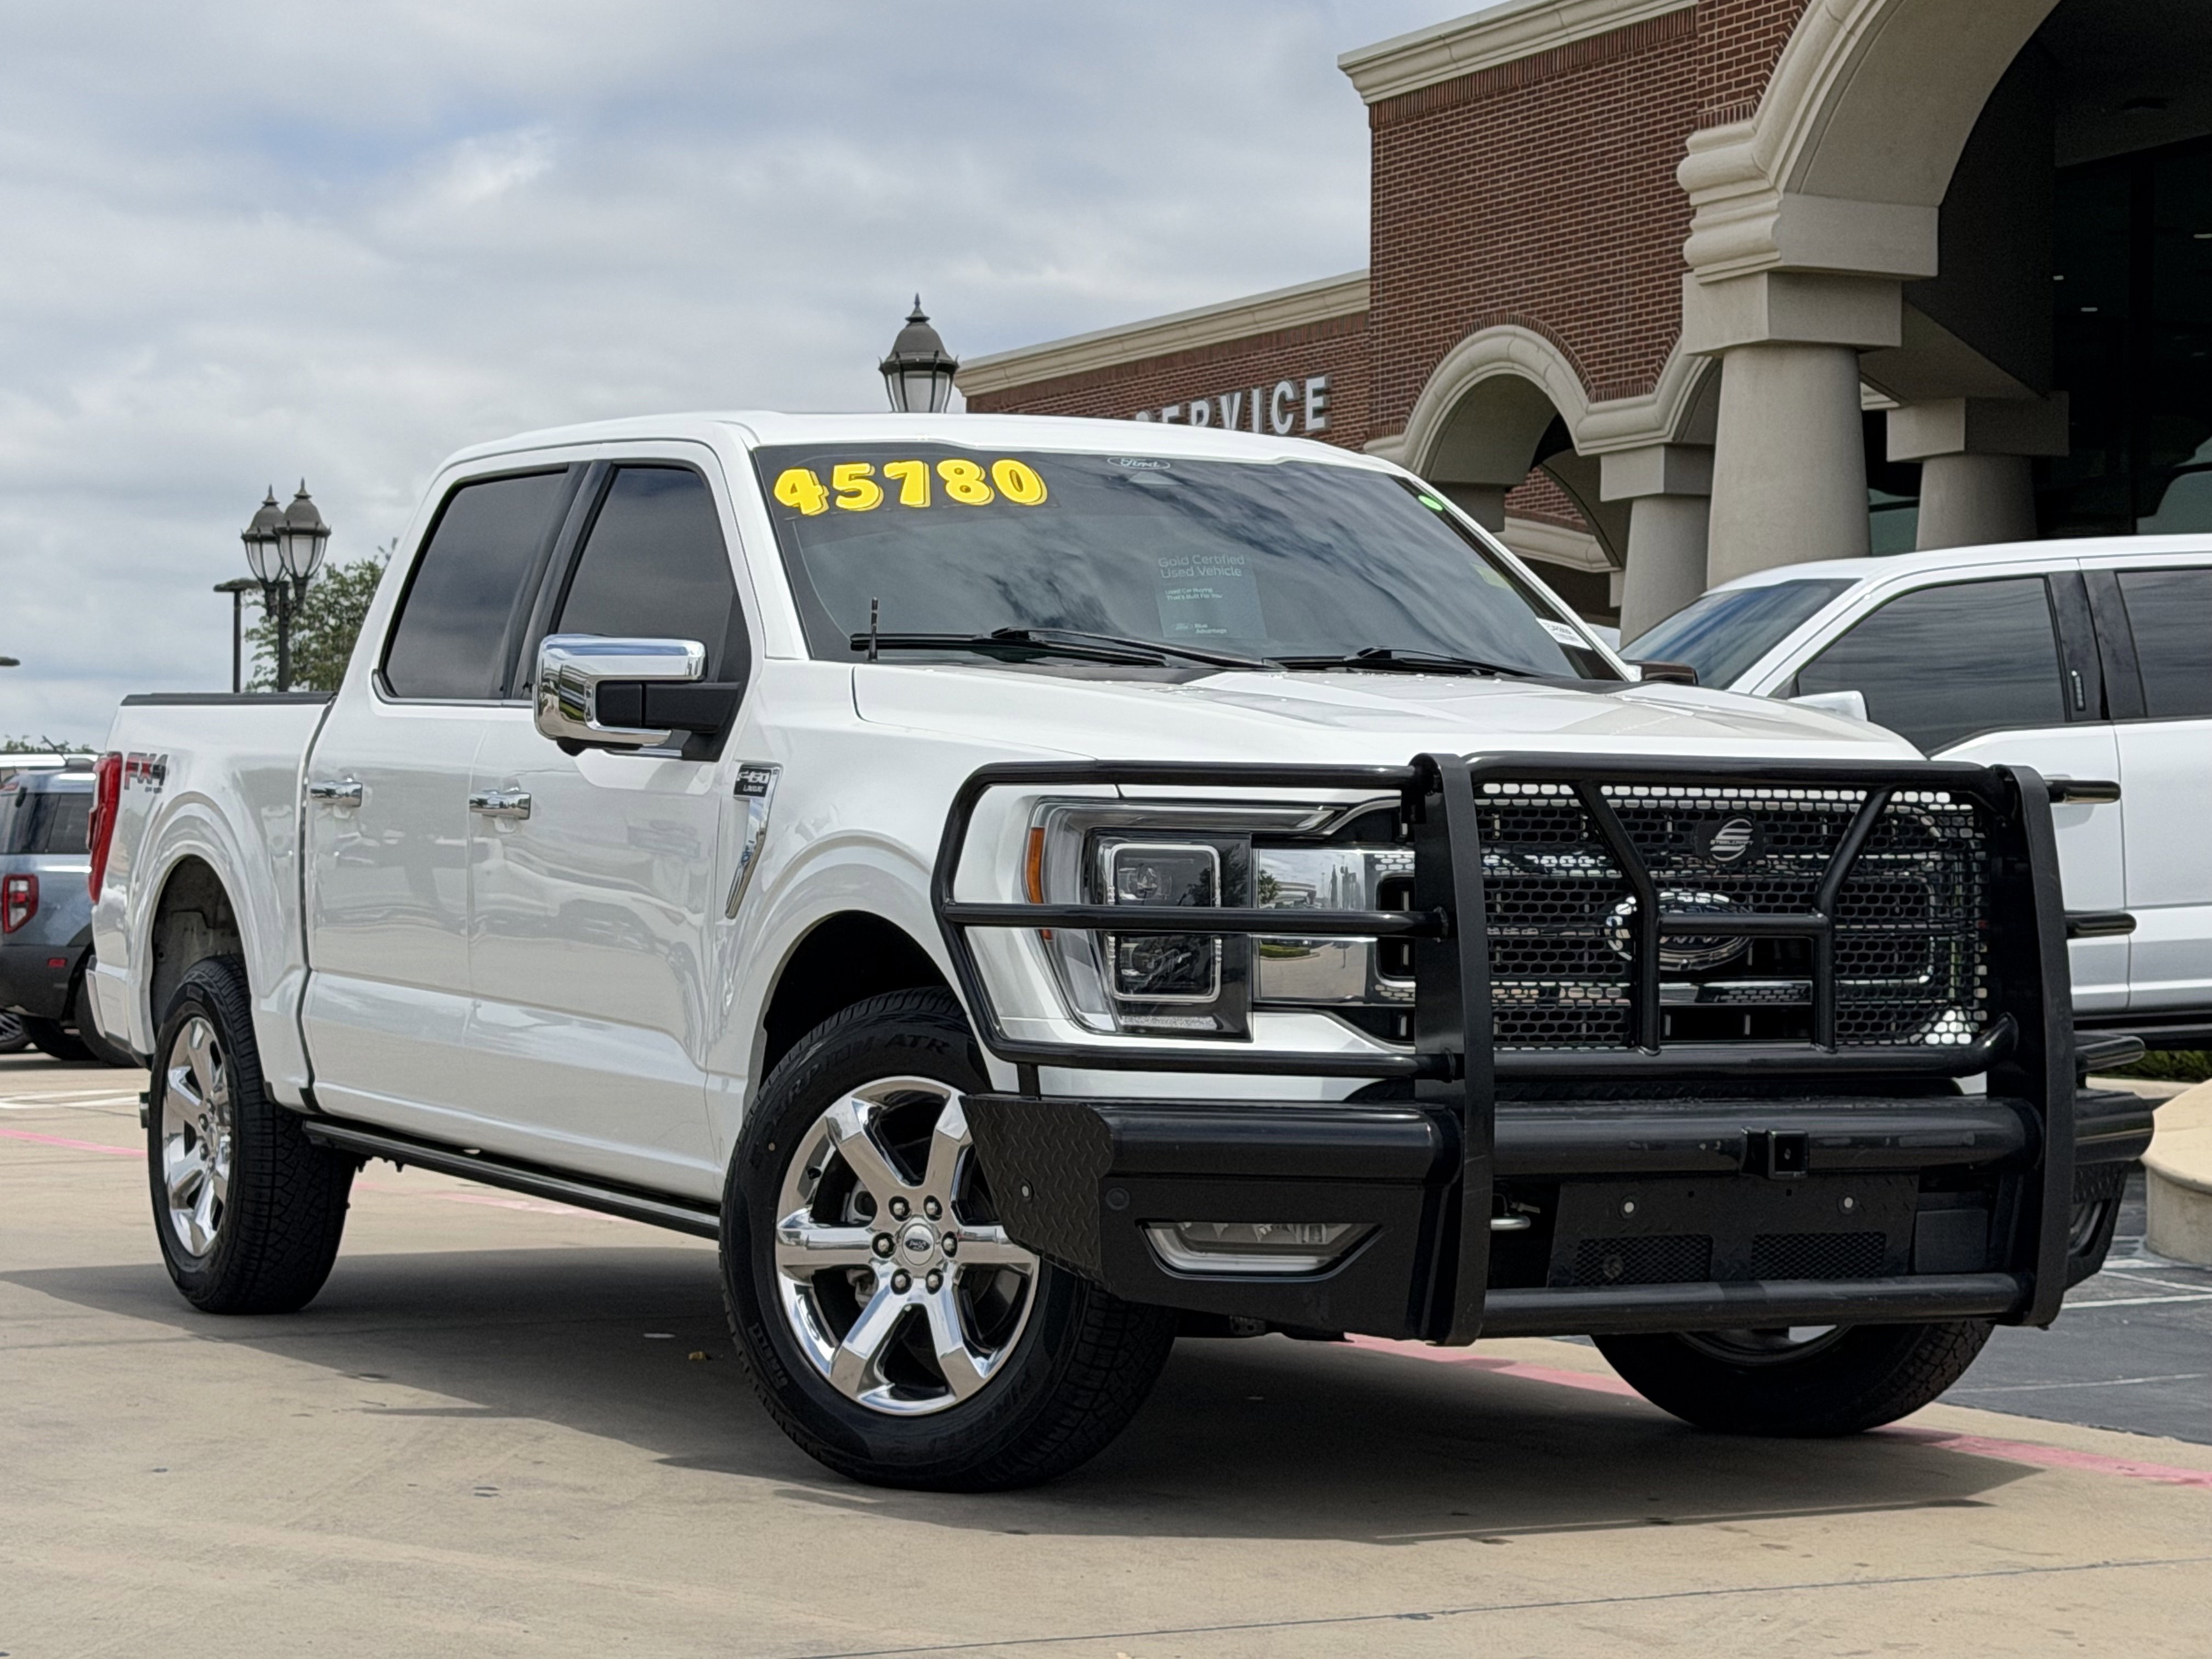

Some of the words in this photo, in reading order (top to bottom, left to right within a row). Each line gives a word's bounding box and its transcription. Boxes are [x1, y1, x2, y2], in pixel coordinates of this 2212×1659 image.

[1136, 375, 1333, 435] RVICE
[1120, 458, 1160, 468] Ford
[774, 459, 1049, 516] 45780
[1158, 555, 1189, 568] Gold
[1192, 554, 1245, 565] Certified
[1160, 566, 1194, 578] Used
[1197, 566, 1243, 577] Vehicle
[124, 752, 168, 790] FX4
[883, 1032, 950, 1055] ATR
